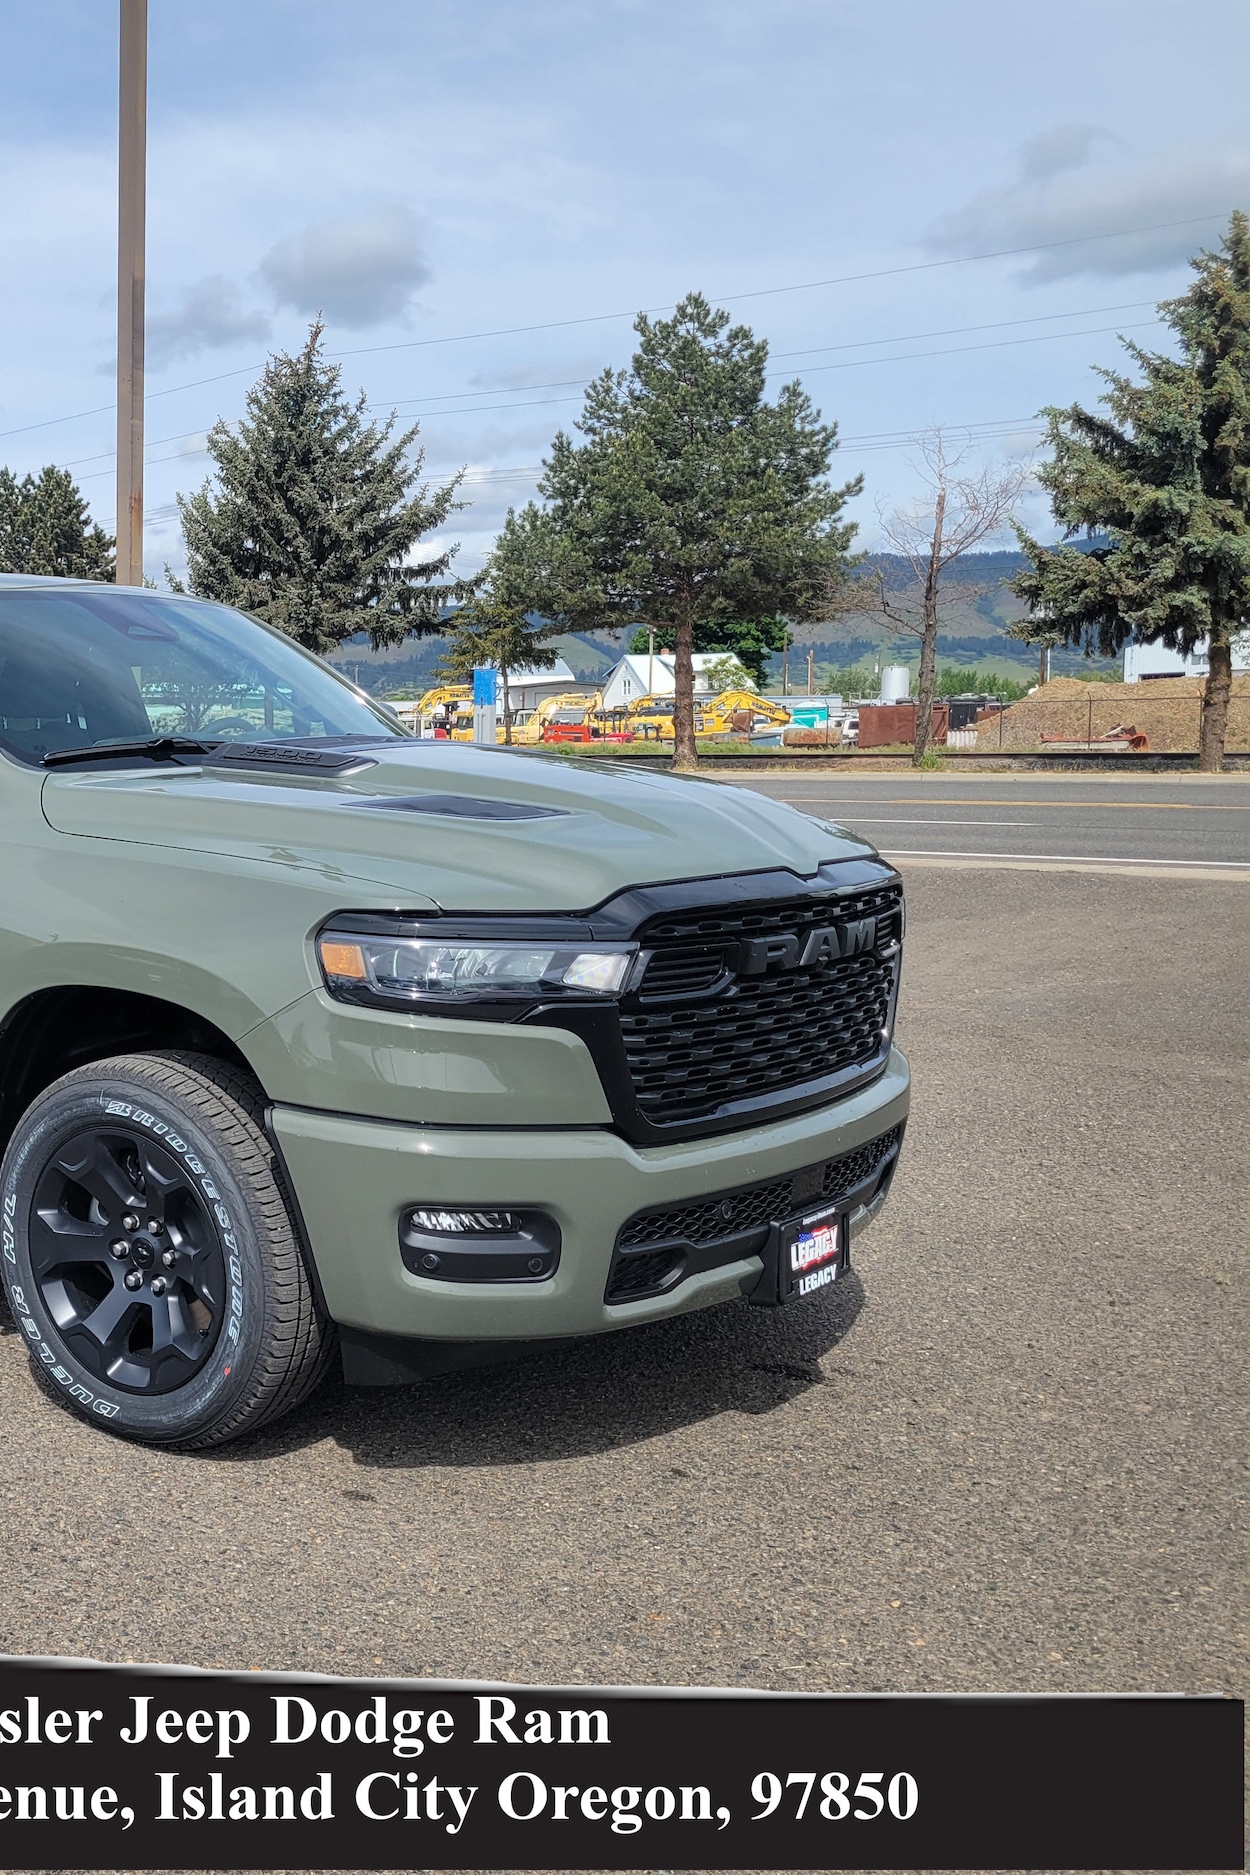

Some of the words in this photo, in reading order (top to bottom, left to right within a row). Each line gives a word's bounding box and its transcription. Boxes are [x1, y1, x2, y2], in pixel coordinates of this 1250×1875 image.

[740, 916, 876, 975] RAM
[1, 1193, 17, 1265] H/L
[105, 1100, 243, 1347] BRIDGESTONE
[791, 1227, 838, 1271] LEGACY
[799, 1263, 837, 1296] LEGACY
[13, 1286, 120, 1418] DUELER
